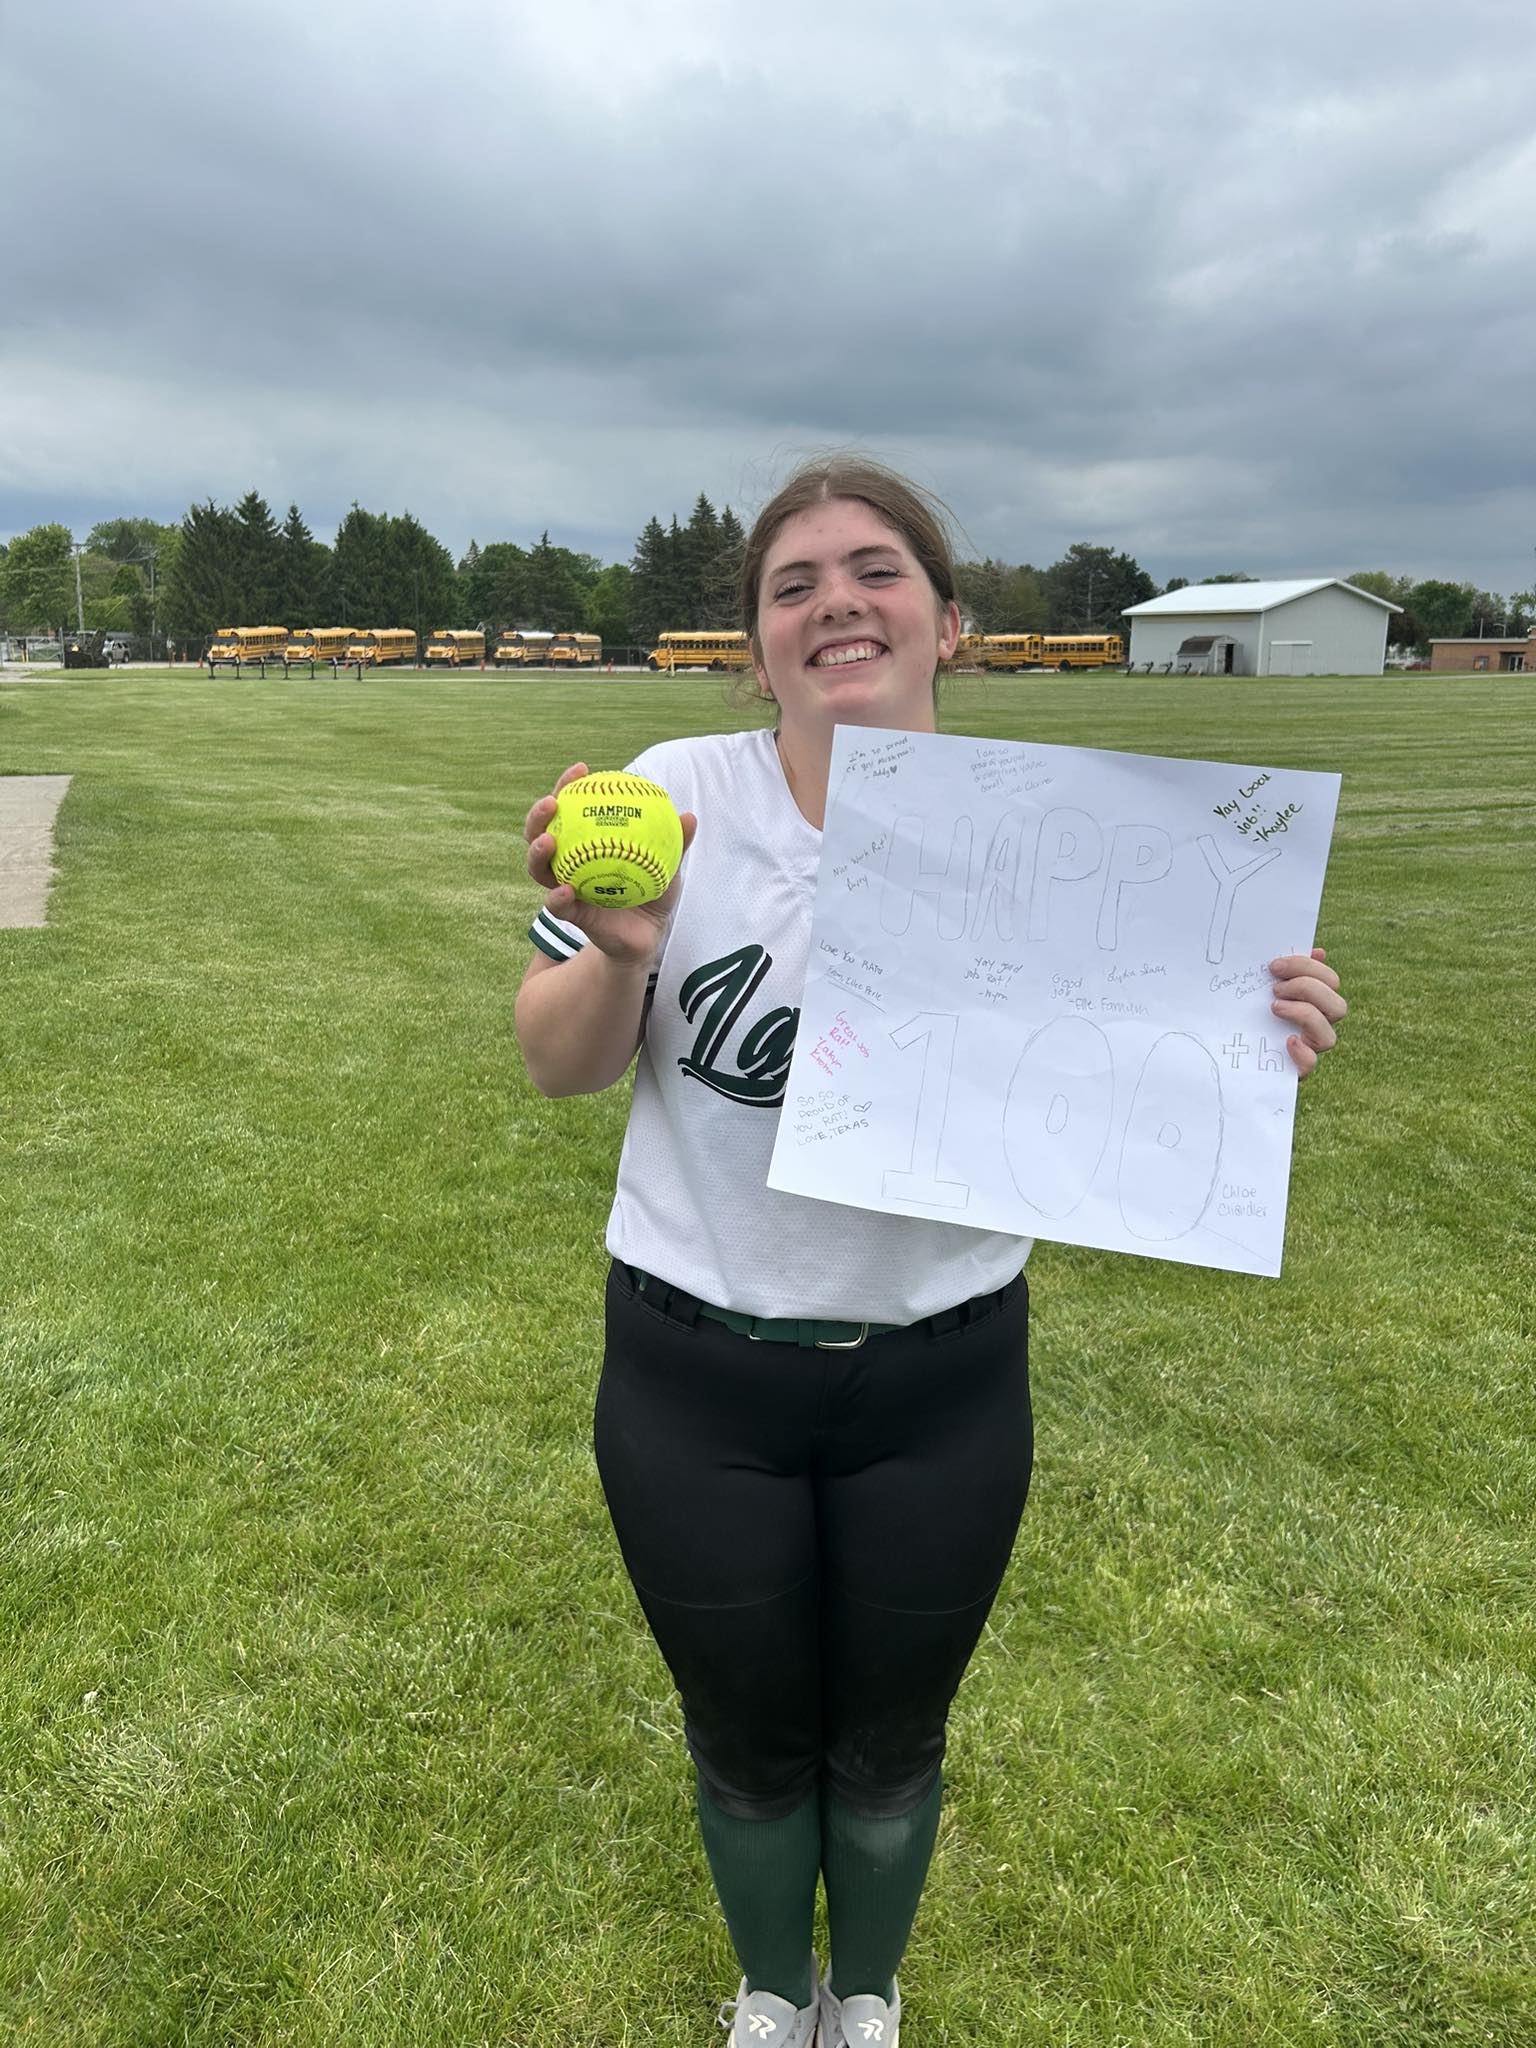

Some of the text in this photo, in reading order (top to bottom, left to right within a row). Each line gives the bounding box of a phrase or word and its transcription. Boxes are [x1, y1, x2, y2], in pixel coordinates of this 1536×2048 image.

[583, 805, 642, 819] CHAMPION
[1212, 800, 1241, 819] Yay
[1252, 803, 1304, 842] -Kaylee
[595, 886, 627, 896] SST
[880, 807, 1283, 966] HAPPY
[819, 939, 838, 956] Love
[1051, 973, 1083, 989] Good
[798, 1095, 851, 1118] PROUD OF
[822, 1110, 848, 1127] RAT!
[828, 1118, 869, 1137] TEXAS
[882, 1012, 1224, 1242] 100
[1222, 1184, 1257, 1199] Chloe
